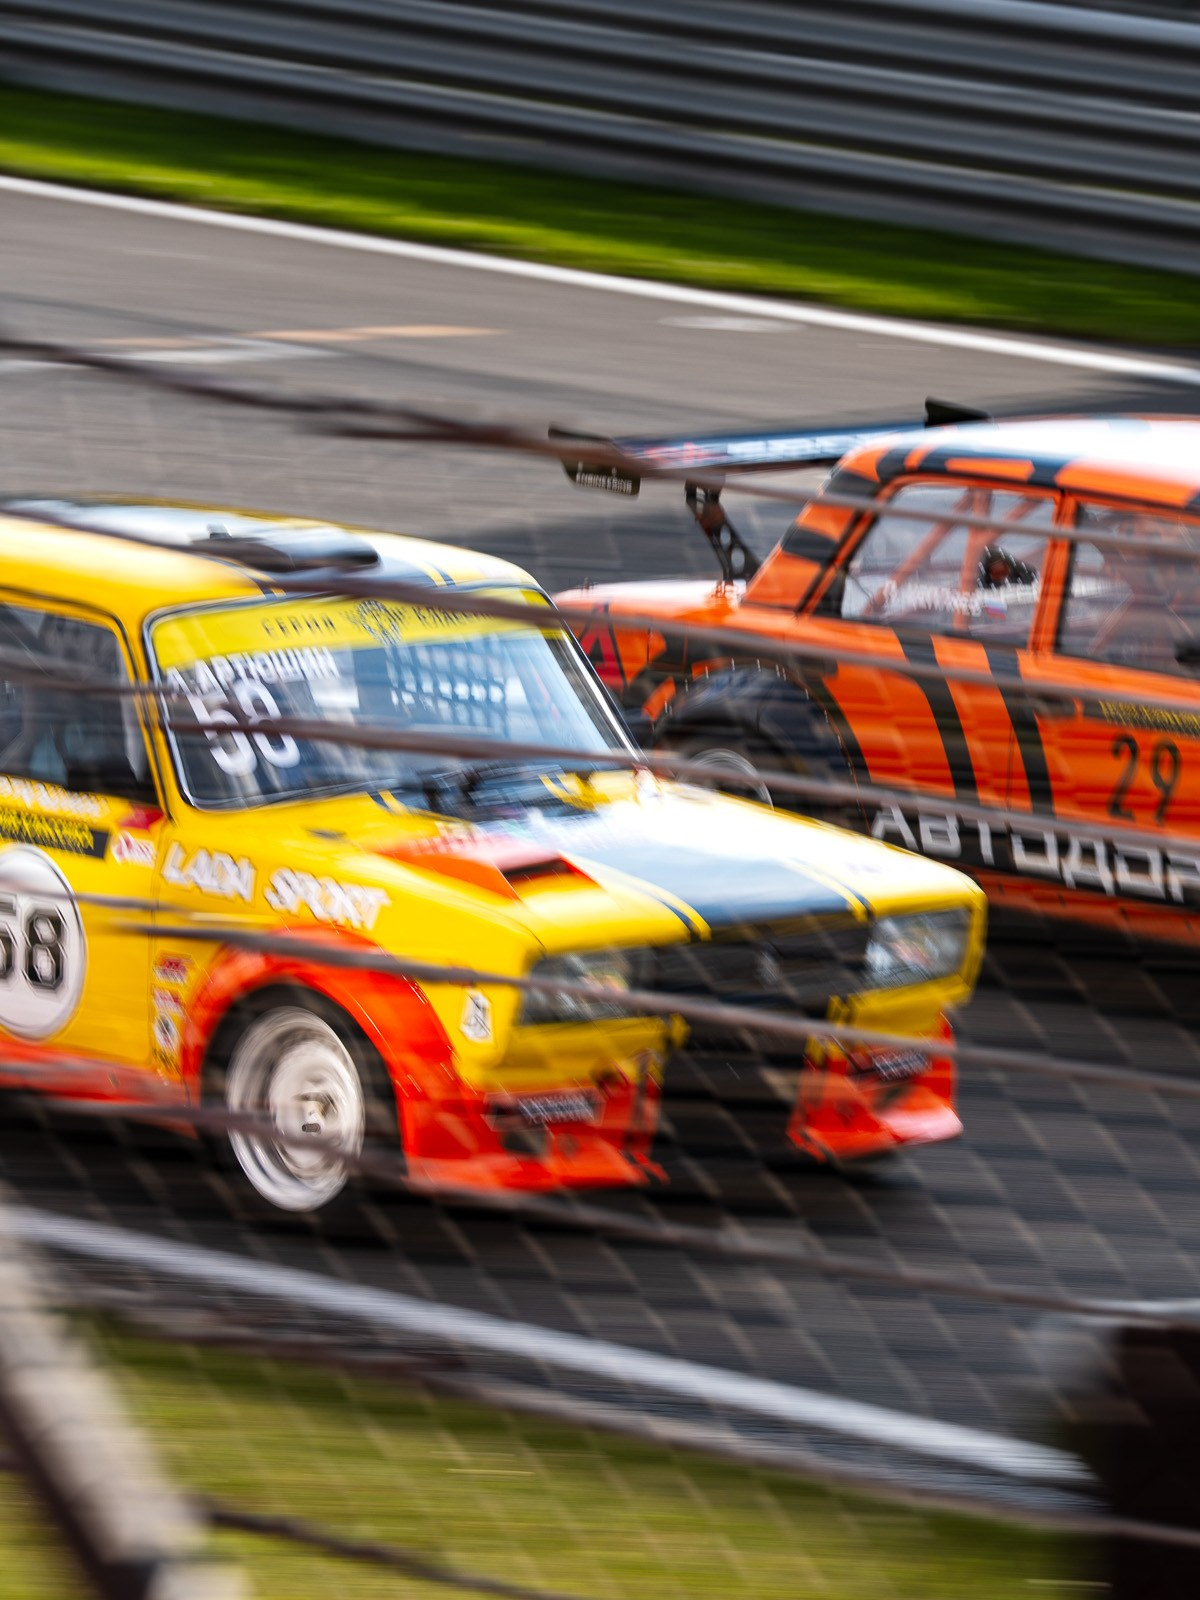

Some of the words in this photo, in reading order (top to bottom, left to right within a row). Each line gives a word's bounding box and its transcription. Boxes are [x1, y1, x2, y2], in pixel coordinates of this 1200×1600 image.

[185, 677, 301, 777] 58
[1107, 732, 1181, 826] 29
[161, 840, 256, 903] LADA
[264, 867, 391, 930] SPORT
